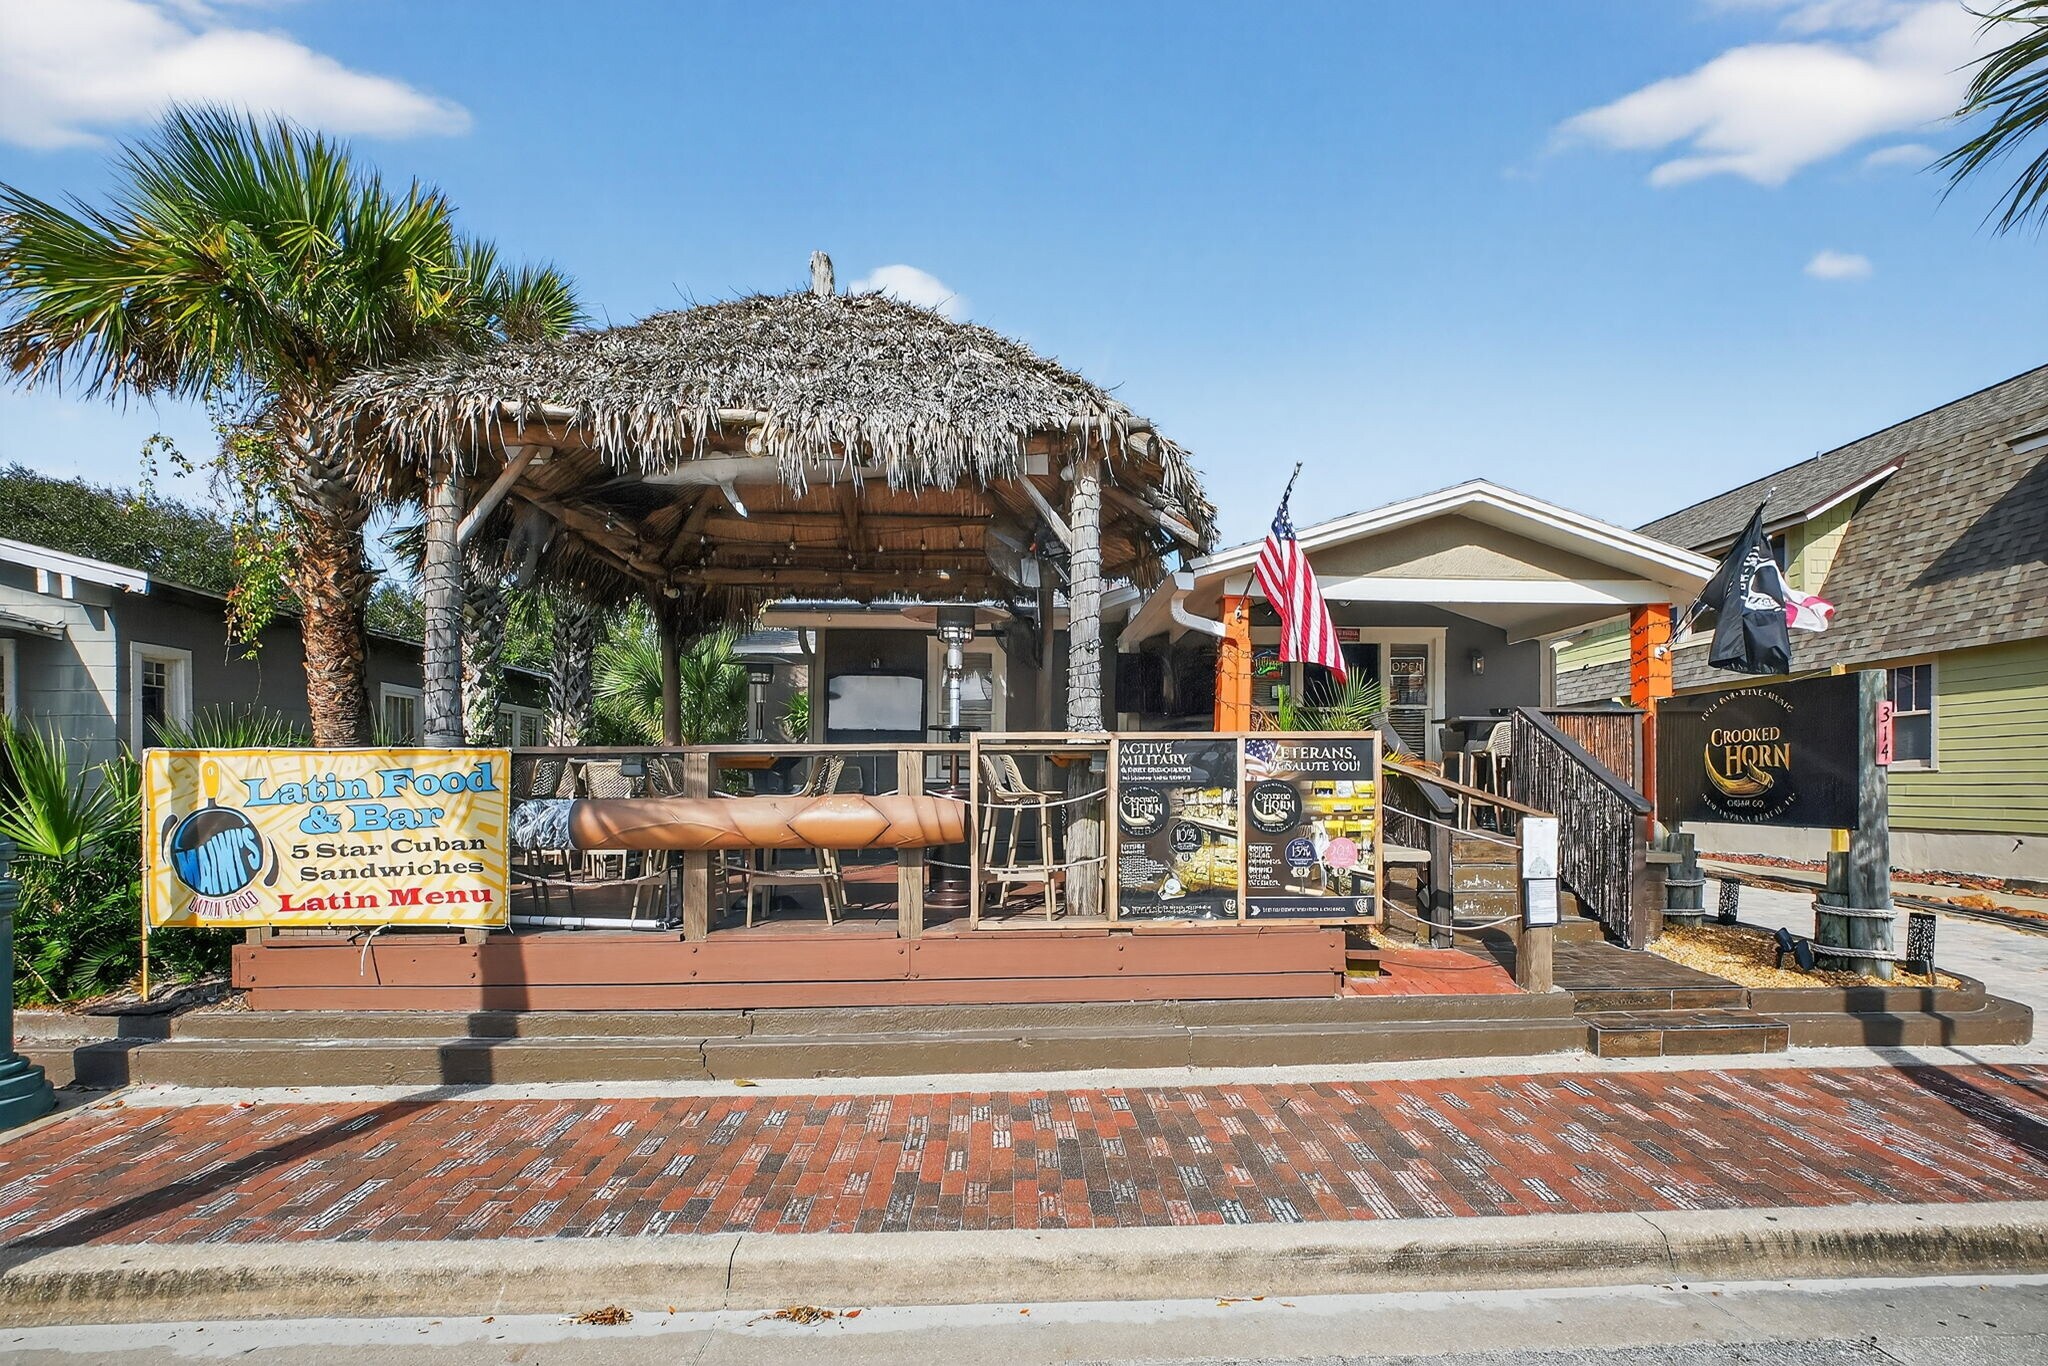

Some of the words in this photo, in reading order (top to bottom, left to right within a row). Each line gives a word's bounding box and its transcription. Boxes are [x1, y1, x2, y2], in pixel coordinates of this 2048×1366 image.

[1392, 661, 1422, 673] OPEN
[1711, 726, 1780, 748] CROOKED
[1880, 706, 1890, 761] 314
[1120, 743, 1172, 754] ACTIVE
[1267, 743, 1357, 760] VETERANS,
[1724, 742, 1791, 777] HORN
[1120, 754, 1187, 766] MILITARY
[1284, 760, 1330, 772] SALUTE
[1332, 760, 1361, 772] YOU!
[240, 776, 371, 807] Latin
[374, 761, 498, 798] Food
[300, 806, 341, 834] &
[347, 803, 445, 833] Bar
[291, 844, 310, 859] 5
[316, 842, 383, 858] Star
[391, 836, 487, 853] Cuban
[300, 860, 485, 882] Sandwiches
[278, 893, 384, 912] Latin
[388, 887, 493, 907] Menu
